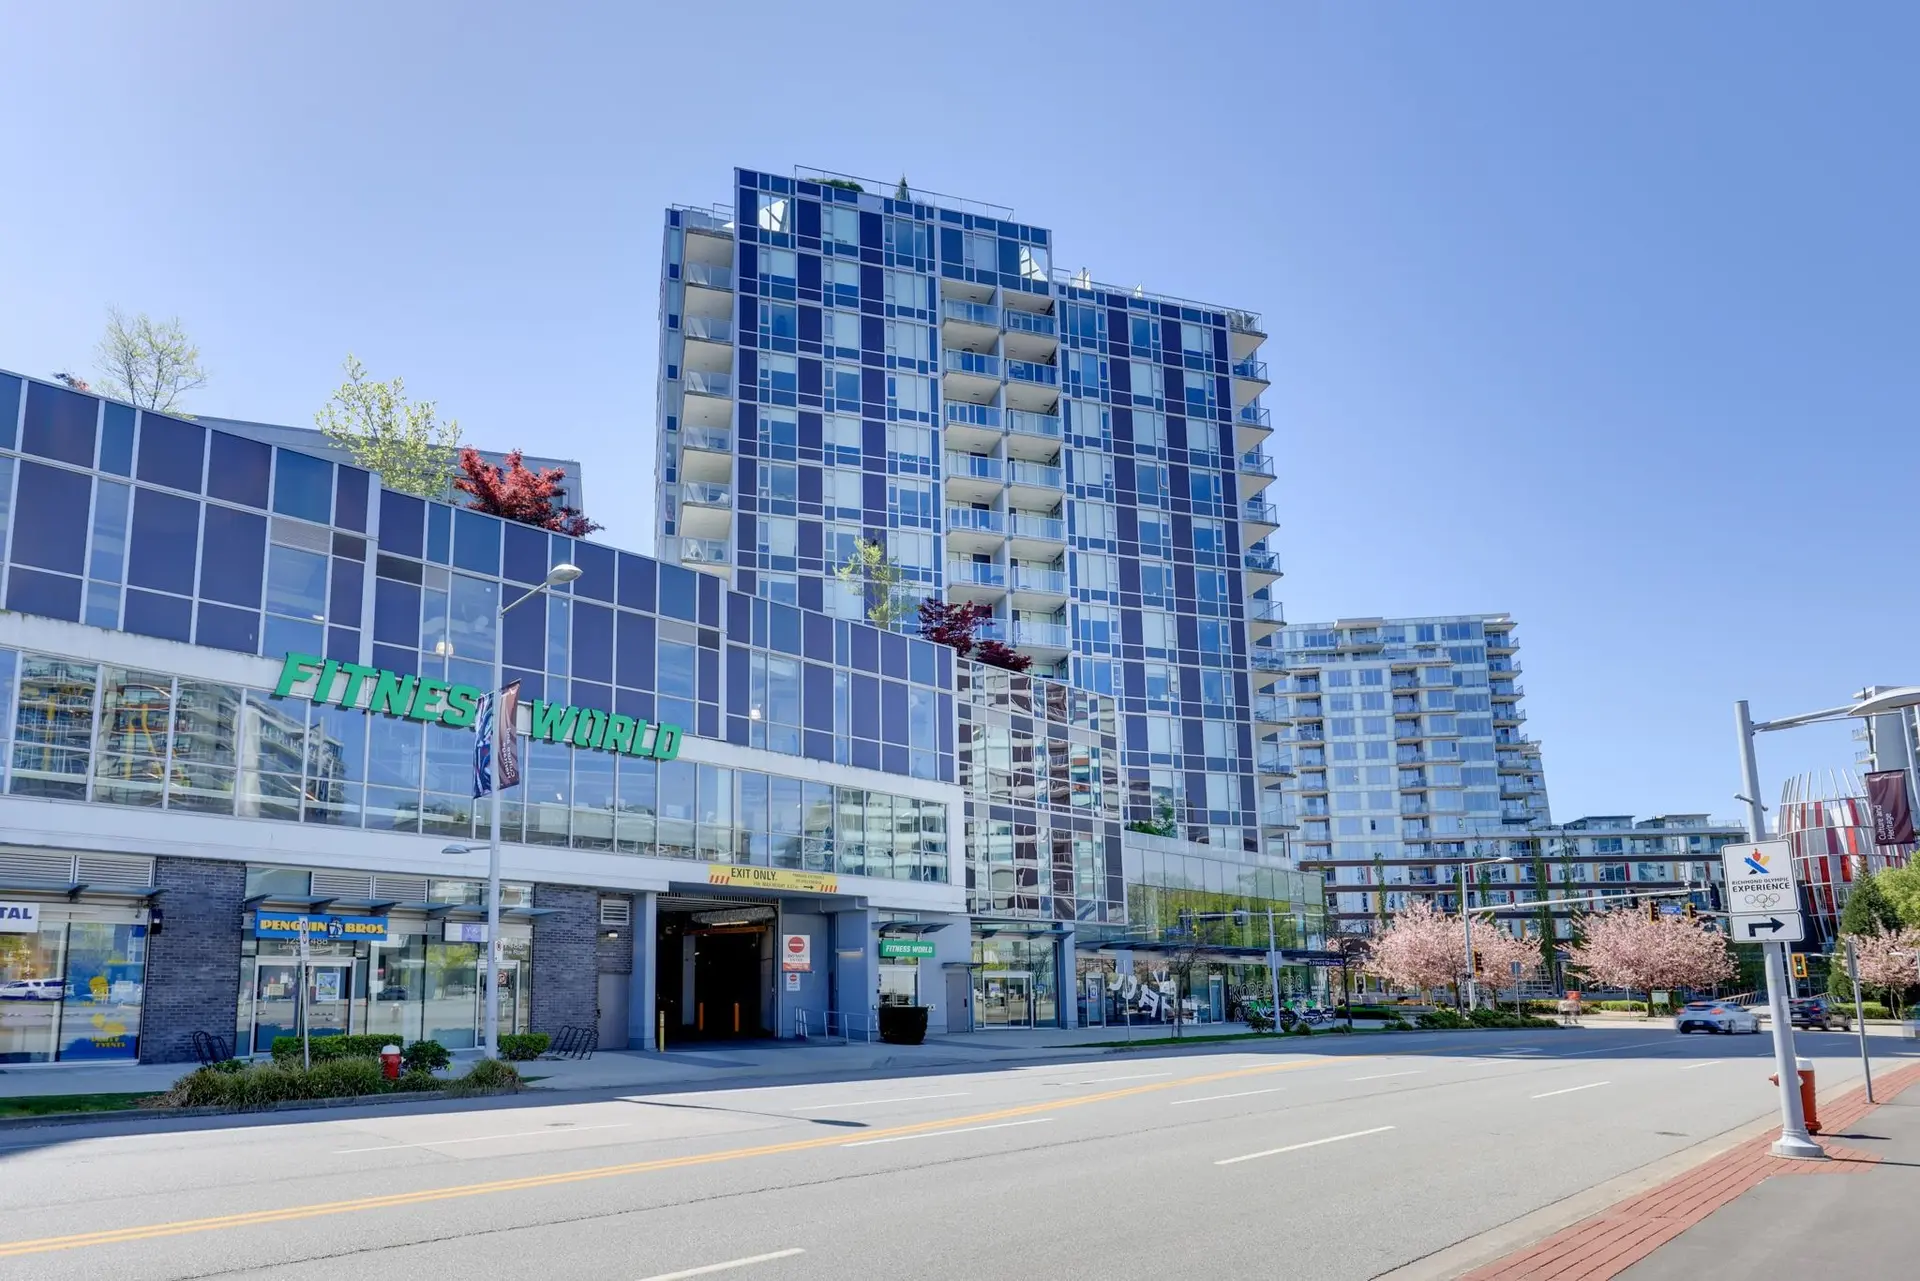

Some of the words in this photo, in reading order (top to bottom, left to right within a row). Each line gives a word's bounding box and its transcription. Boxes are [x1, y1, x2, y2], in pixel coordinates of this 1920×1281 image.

[276, 652, 482, 728] FITNES
[530, 699, 682, 760] WORLD
[1873, 804, 1883, 817] and
[1877, 818, 1887, 840] Culture
[1885, 813, 1895, 840] Heritage
[731, 867, 751, 879] EXIT
[1732, 882, 1790, 892] EXPERIENCE
[885, 945, 911, 953] FITNESS
[912, 945, 933, 954] WORLD
